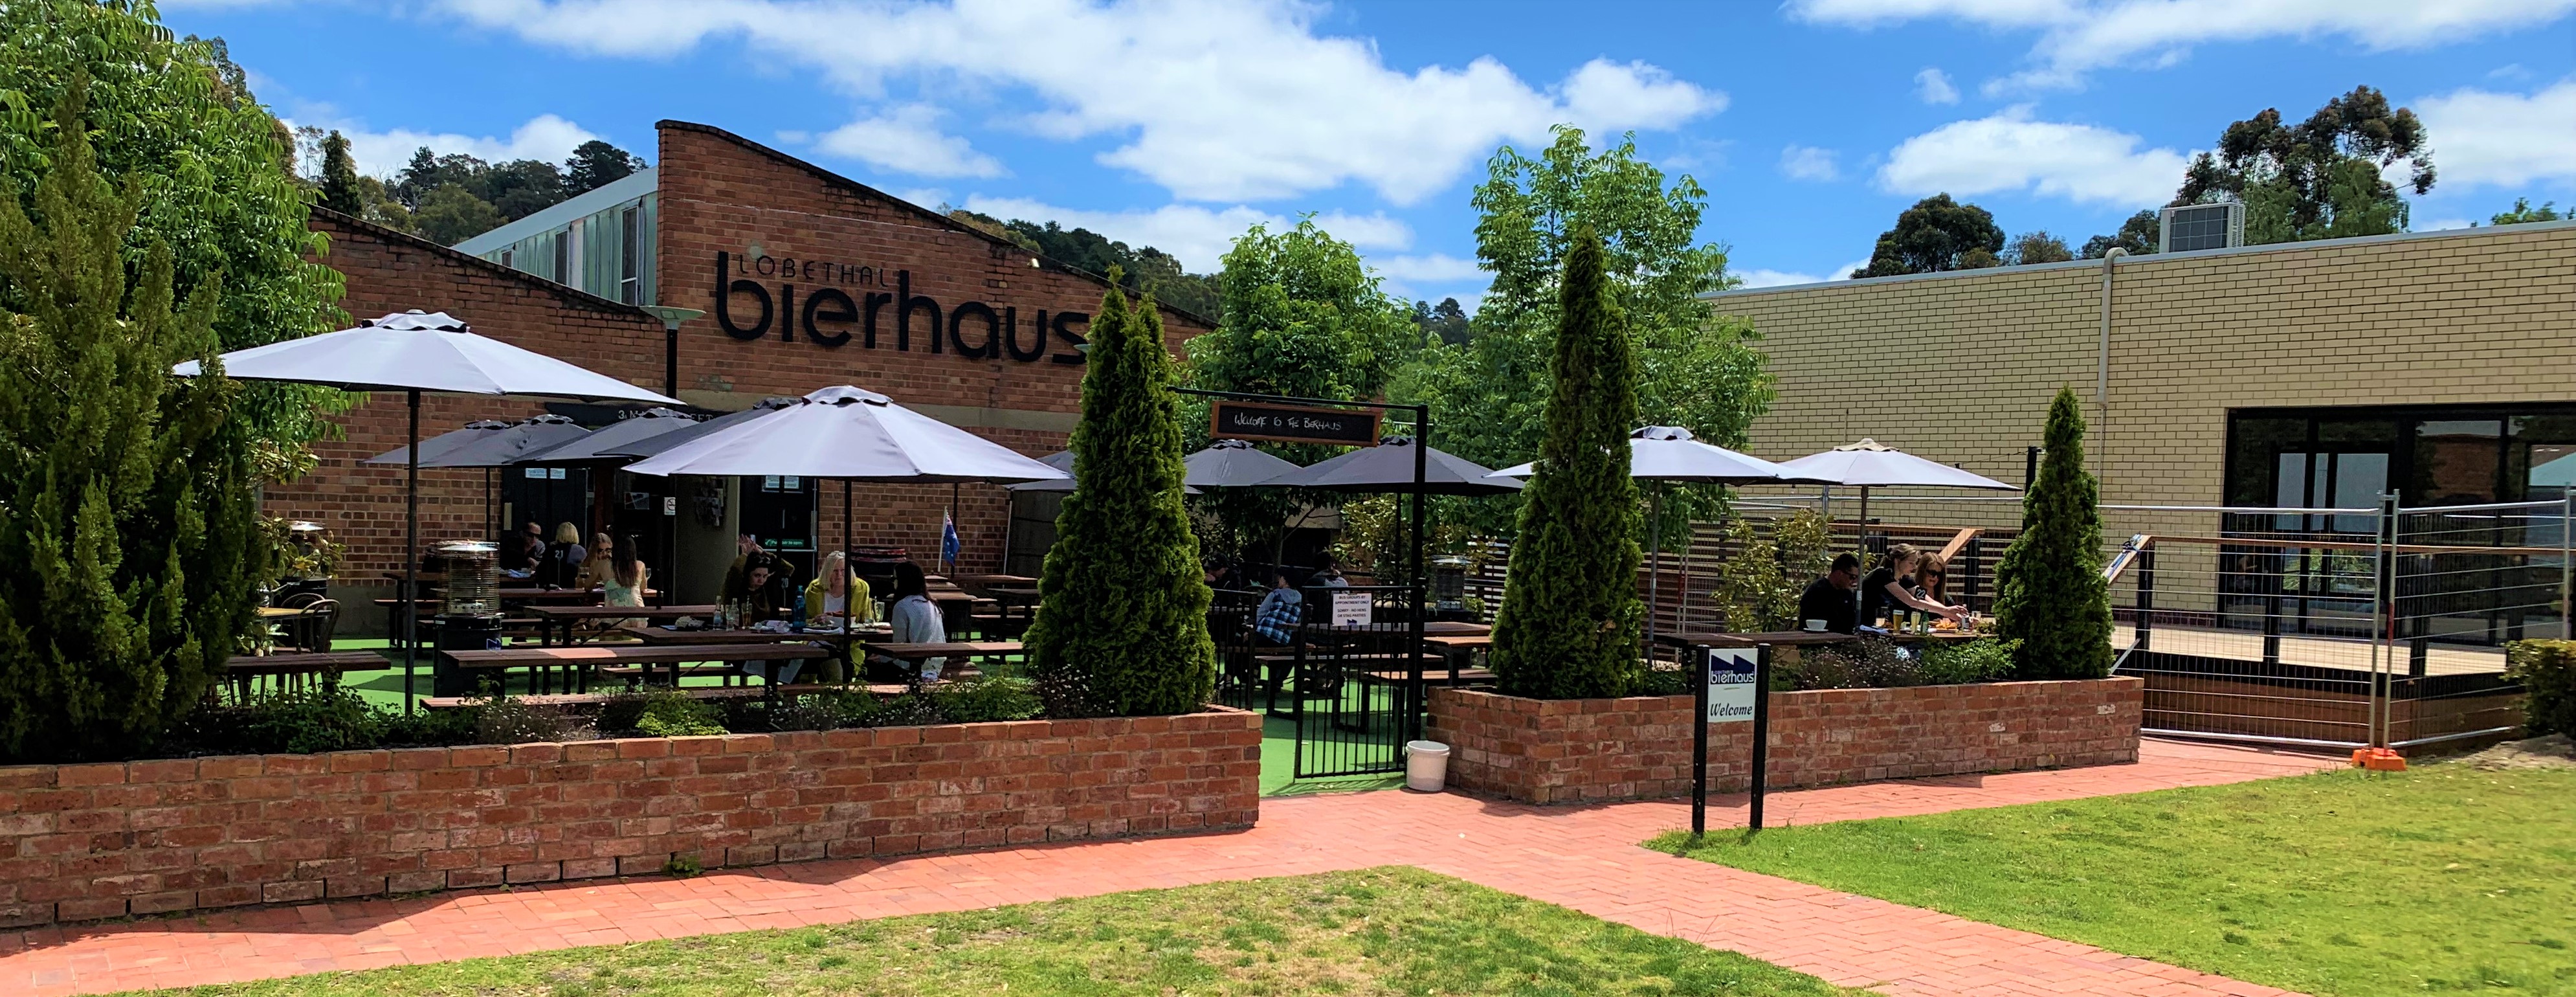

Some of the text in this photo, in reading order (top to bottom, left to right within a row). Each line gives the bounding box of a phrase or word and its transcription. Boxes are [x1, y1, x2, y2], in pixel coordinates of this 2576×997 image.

[738, 254, 887, 287] LOBETHAL
[716, 251, 1090, 364] bierhaus
[555, 550, 563, 558] 21
[1916, 588, 1926, 599] 22
[1711, 669, 1754, 684] bierhaus
[1710, 702, 1753, 717] Welcome
